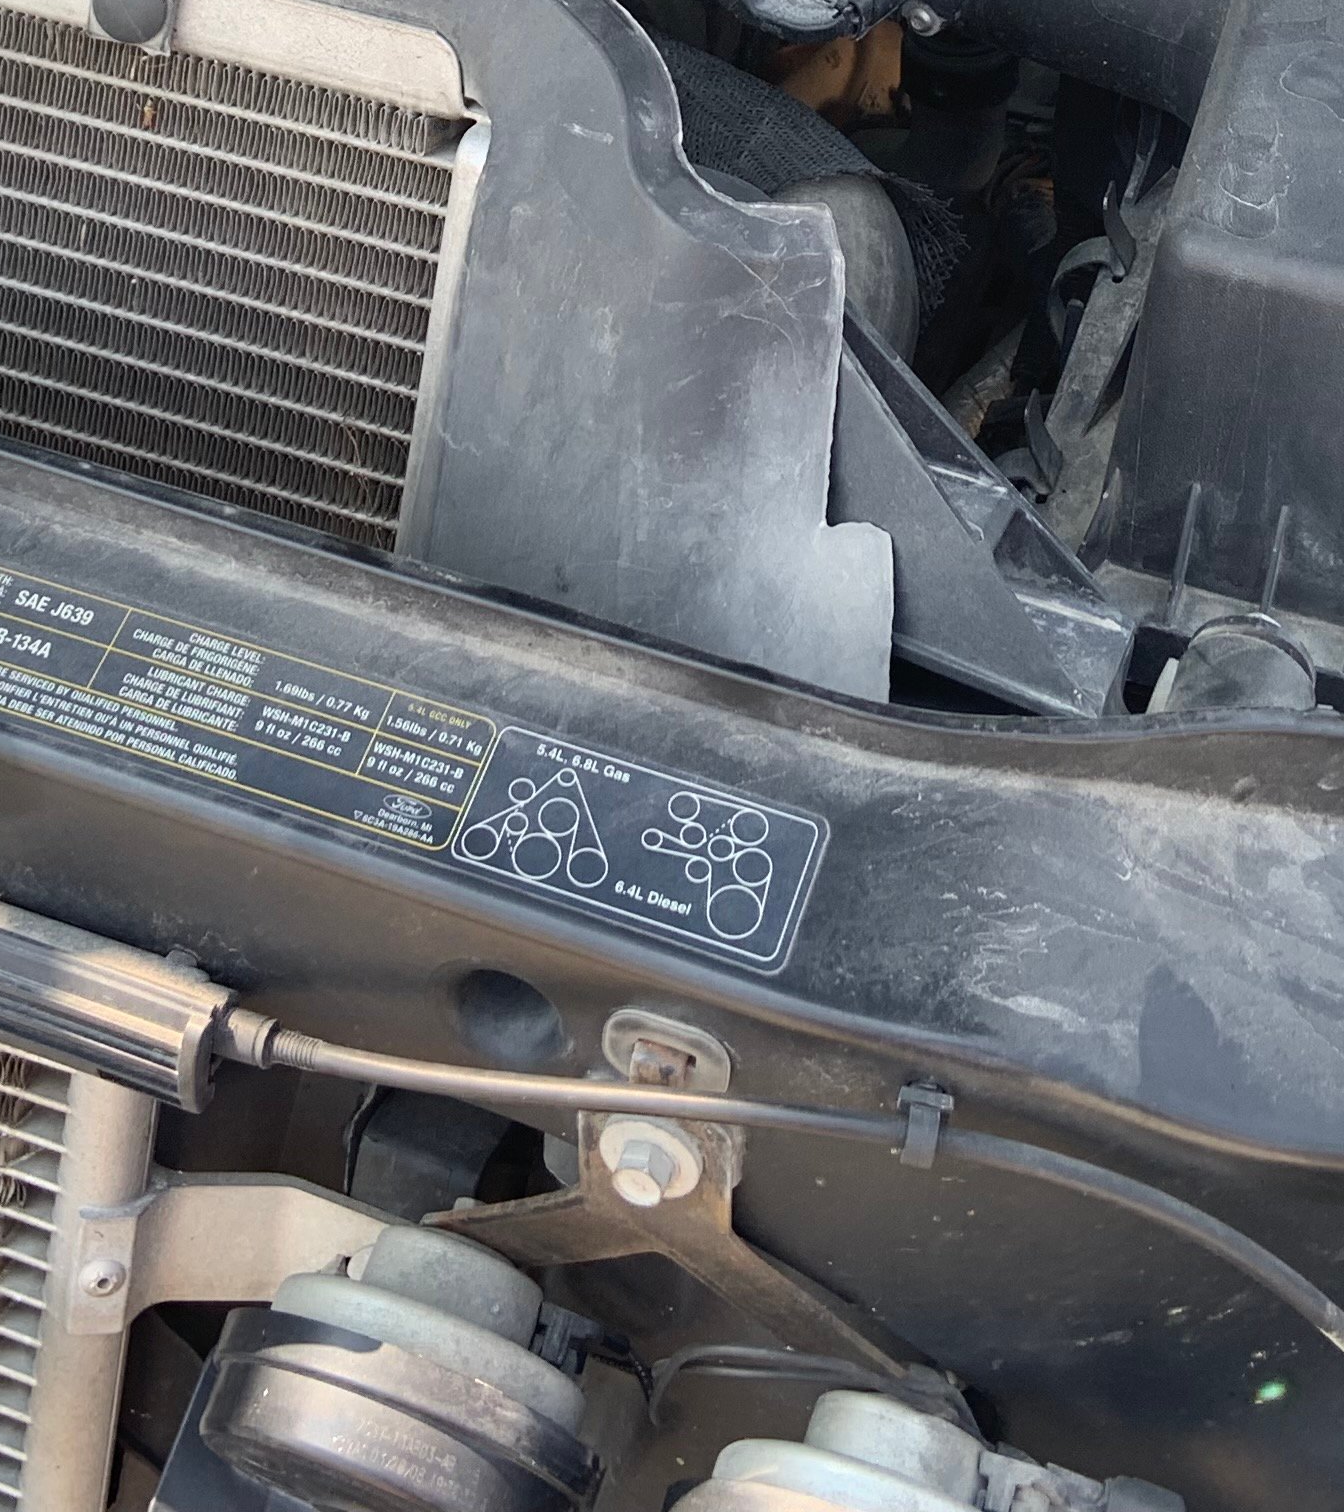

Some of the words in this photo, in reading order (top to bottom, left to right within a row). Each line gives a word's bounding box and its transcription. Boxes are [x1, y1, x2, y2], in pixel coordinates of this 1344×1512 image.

[15, 591, 51, 611] SAE
[50, 603, 94, 624] J639
[133, 629, 175, 648] CHARGE
[174, 642, 191, 653] DE
[189, 633, 231, 653] CHARGE
[231, 647, 266, 663] LEVEL:
[152, 649, 187, 666] CARGA
[188, 659, 205, 671] DE
[204, 665, 254, 687] LLENADO:
[13, 673, 56, 691] SERVICED
[55, 685, 71, 695] BY
[70, 691, 120, 711] QUALIFIED
[120, 706, 177, 730] PERSONNEL.
[123, 674, 166, 693] CHARGE
[165, 686, 181, 699] DE
[181, 692, 244, 717] LUBRIFIANT:
[147, 667, 206, 691] LUBRICANT
[206, 686, 250, 705] CHARGE:
[32, 693, 94, 718] L'ENTRETIEN
[118, 720, 135, 731] UN
[135, 725, 190, 749] PERSONNEL
[118, 687, 154, 704] CARGA
[154, 698, 172, 710] DE
[171, 704, 238, 730] LUBRICANTE:
[262, 707, 351, 741] WSH-M1C231-B
[326, 697, 353, 711] 0.77
[353, 706, 370, 720] Kg
[448, 717, 472, 728] ONLY
[7, 700, 34, 713] DEBE
[34, 708, 56, 720] SER
[55, 715, 104, 735] ATENDIDO
[103, 730, 126, 743] POR
[126, 737, 176, 760] PERSONAL
[178, 754, 237, 779] CALIFICADO.
[254, 720, 265, 730] 9
[276, 729, 292, 739] oz
[301, 736, 326, 750] 266
[326, 745, 342, 756] cc
[438, 732, 463, 747] 0.71
[465, 741, 483, 755] Kg
[366, 757, 376, 767] 9
[388, 766, 404, 776] oz
[414, 772, 438, 787] 266
[439, 783, 455, 793] cc
[374, 743, 464, 778] WSH-M1C231-B
[536, 744, 568, 763] 5.4L,
[571, 755, 599, 772] 6.8L
[603, 765, 630, 782] Gas
[391, 796, 423, 815] Ford
[420, 822, 433, 831] MI
[614, 881, 643, 900] 6.4L
[647, 892, 692, 914] Diesel
